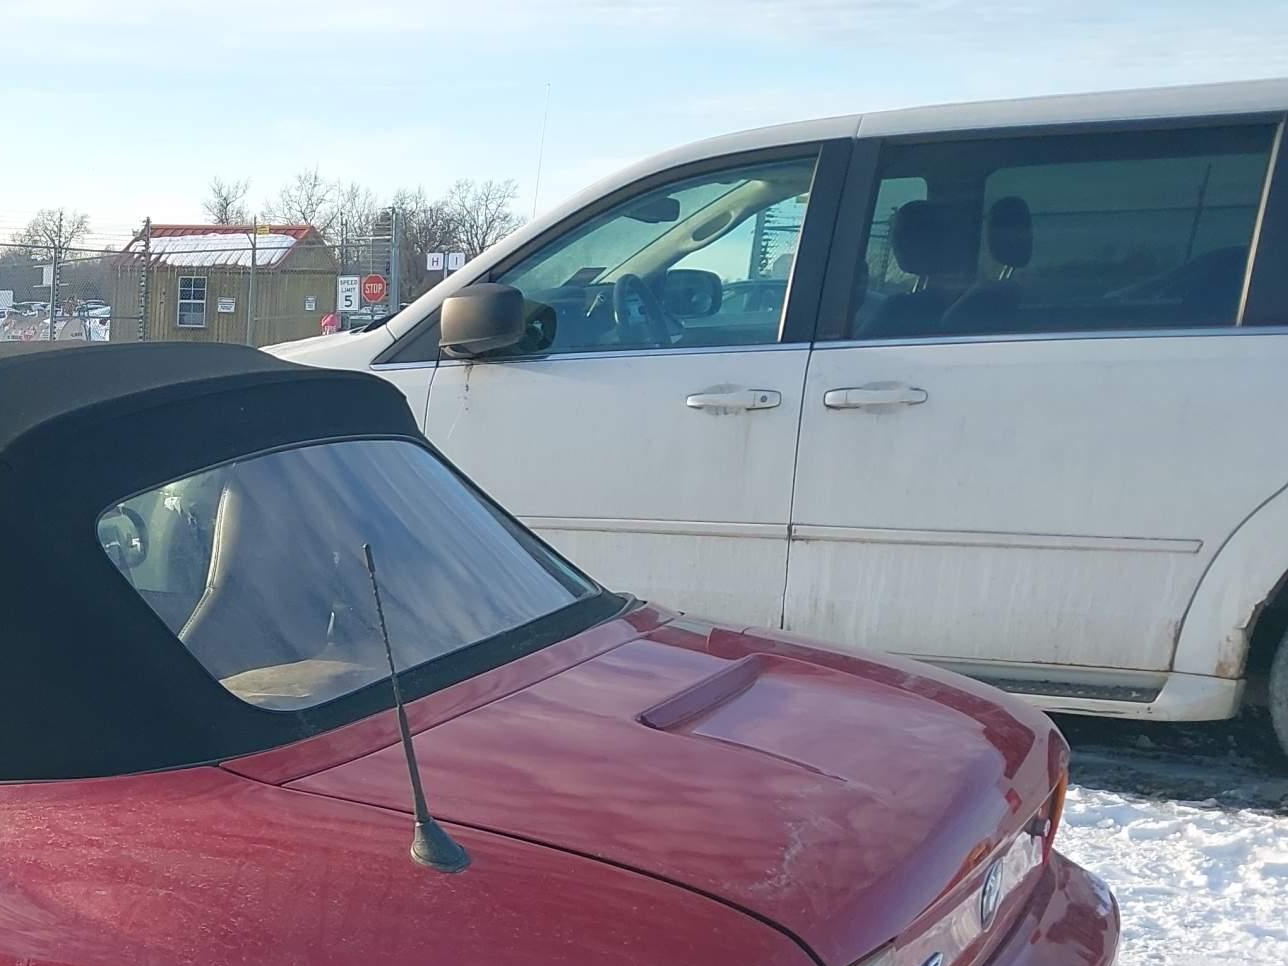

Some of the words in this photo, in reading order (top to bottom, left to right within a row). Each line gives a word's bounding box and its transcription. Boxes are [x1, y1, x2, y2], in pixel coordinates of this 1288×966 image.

[431, 255, 440, 267] H
[365, 283, 383, 294] STOP
[344, 294, 353, 308] 5
